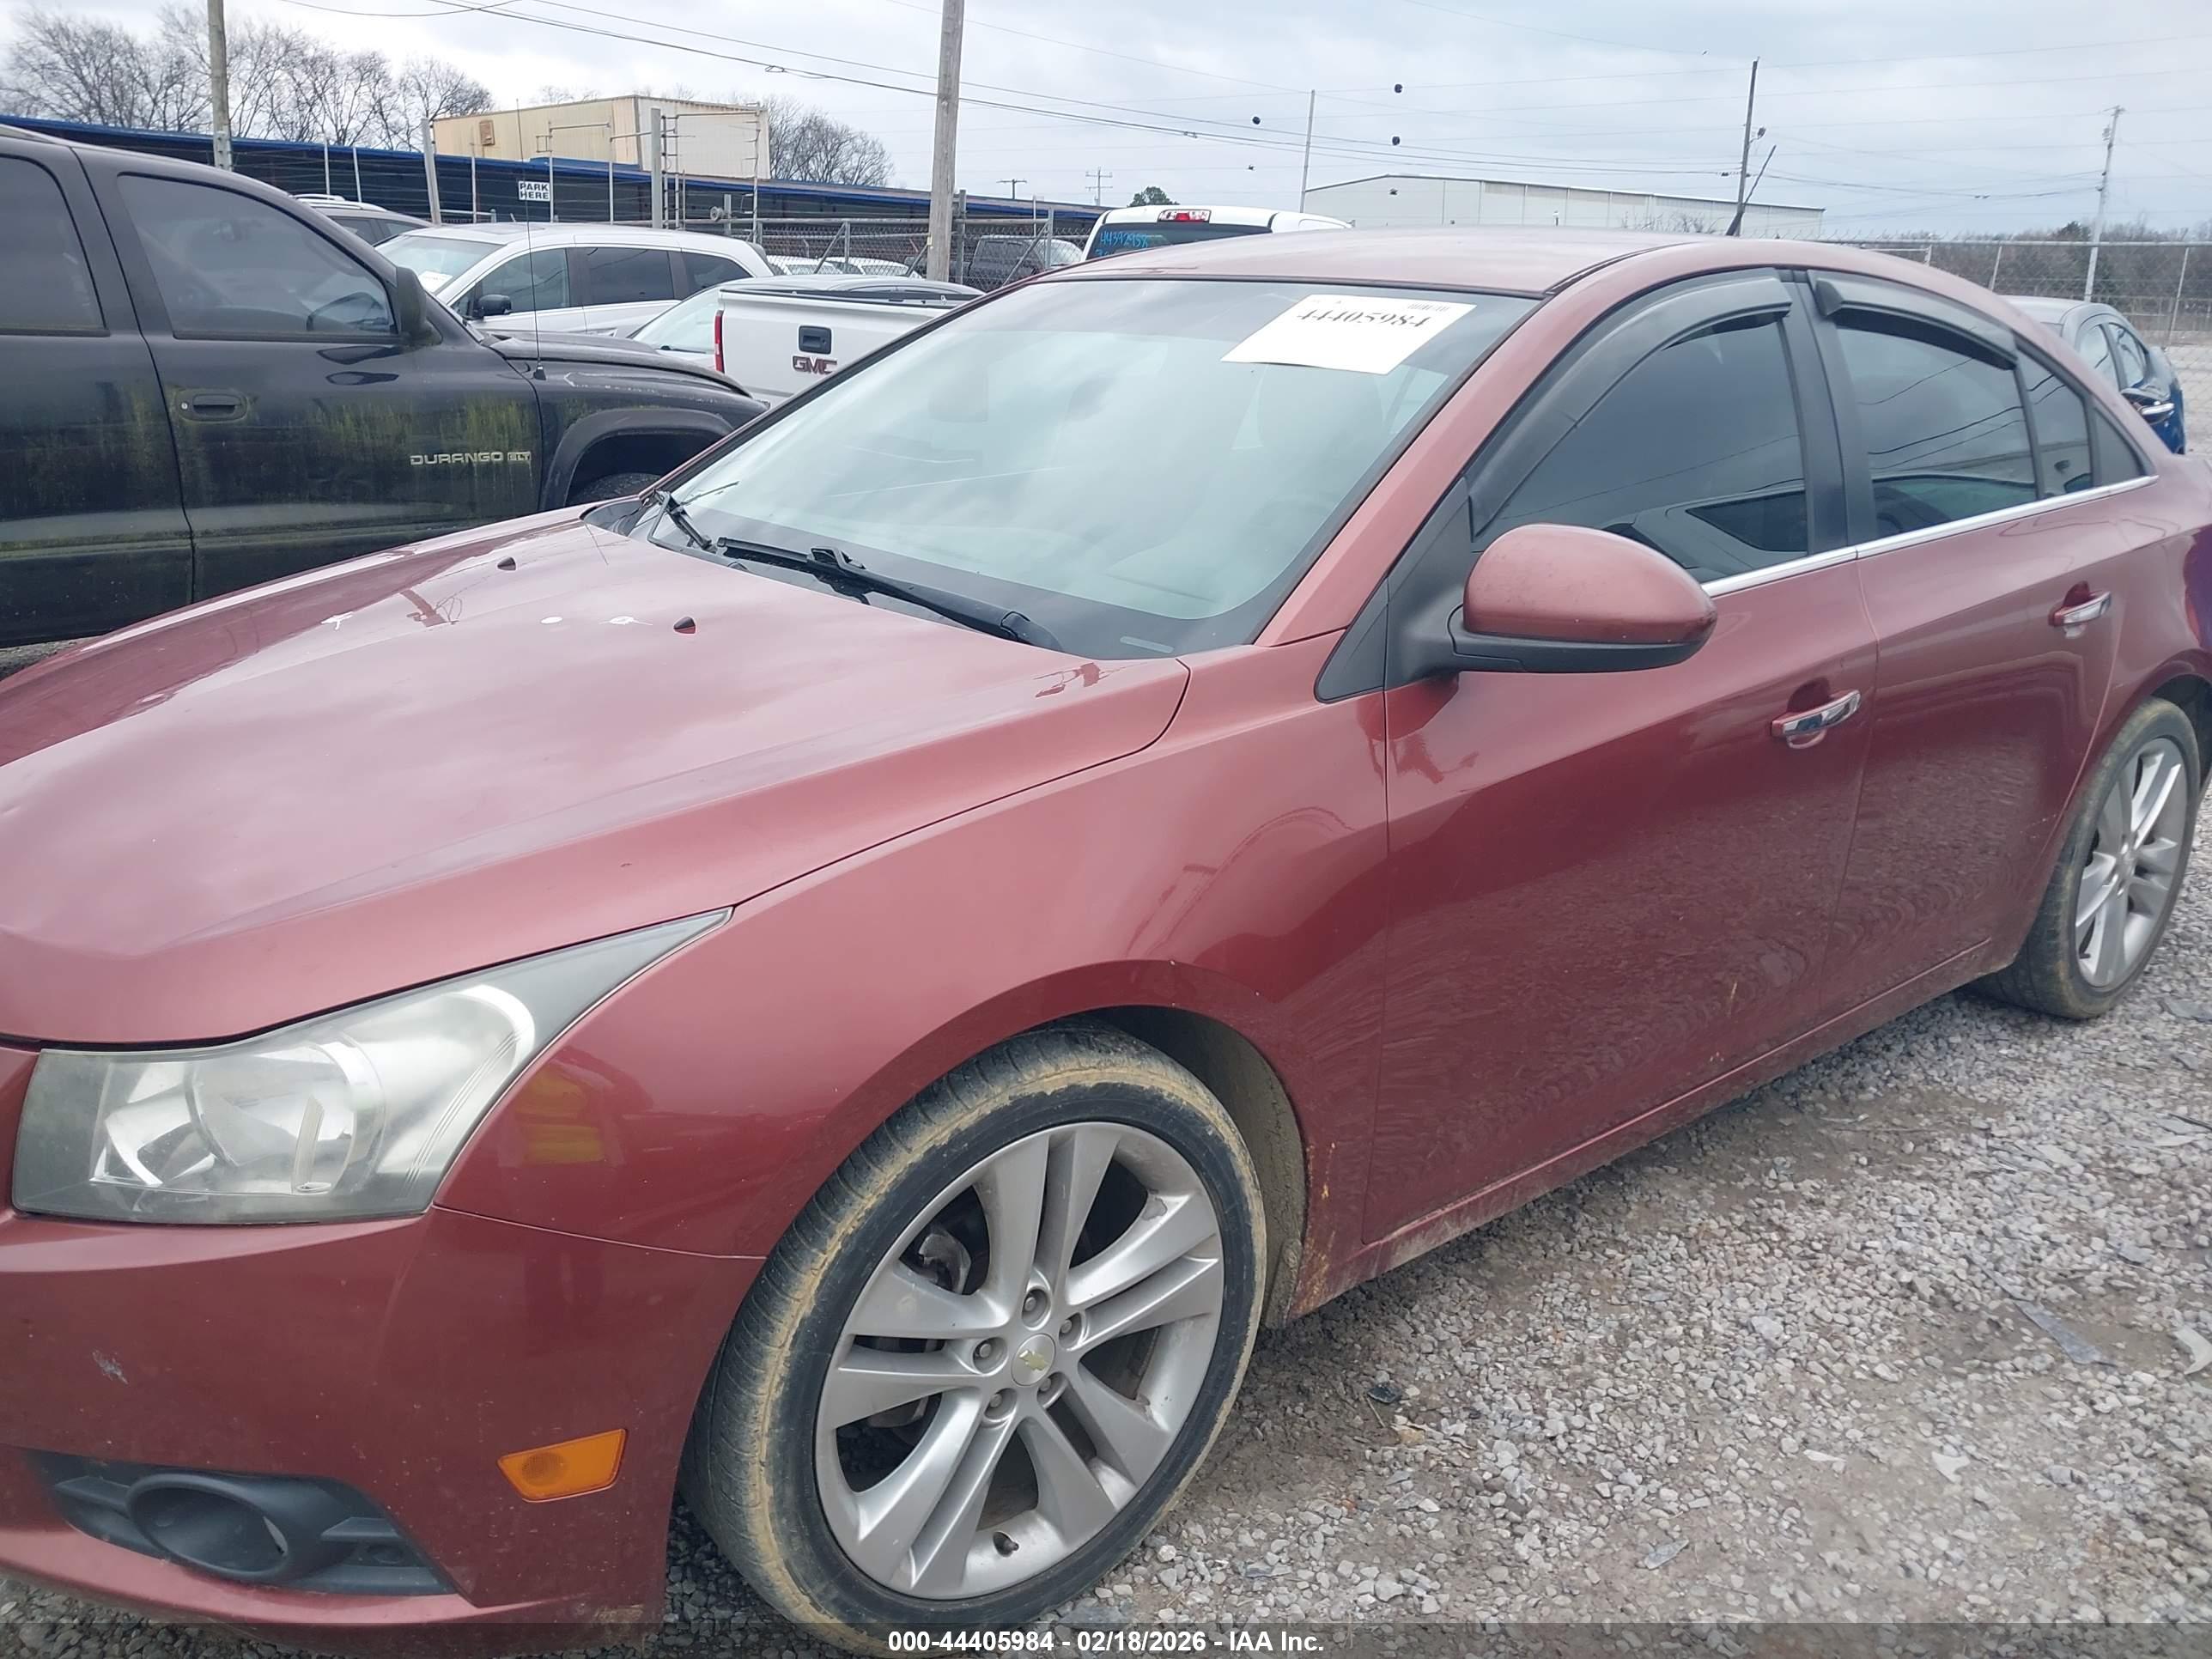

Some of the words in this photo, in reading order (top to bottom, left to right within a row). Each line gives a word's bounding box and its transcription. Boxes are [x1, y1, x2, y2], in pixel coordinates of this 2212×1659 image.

[520, 183, 549, 191] PARK
[520, 191, 549, 200] HERE
[1297, 308, 1432, 327] 44405984
[793, 356, 837, 374] GMC
[410, 452, 503, 465] DURANGO
